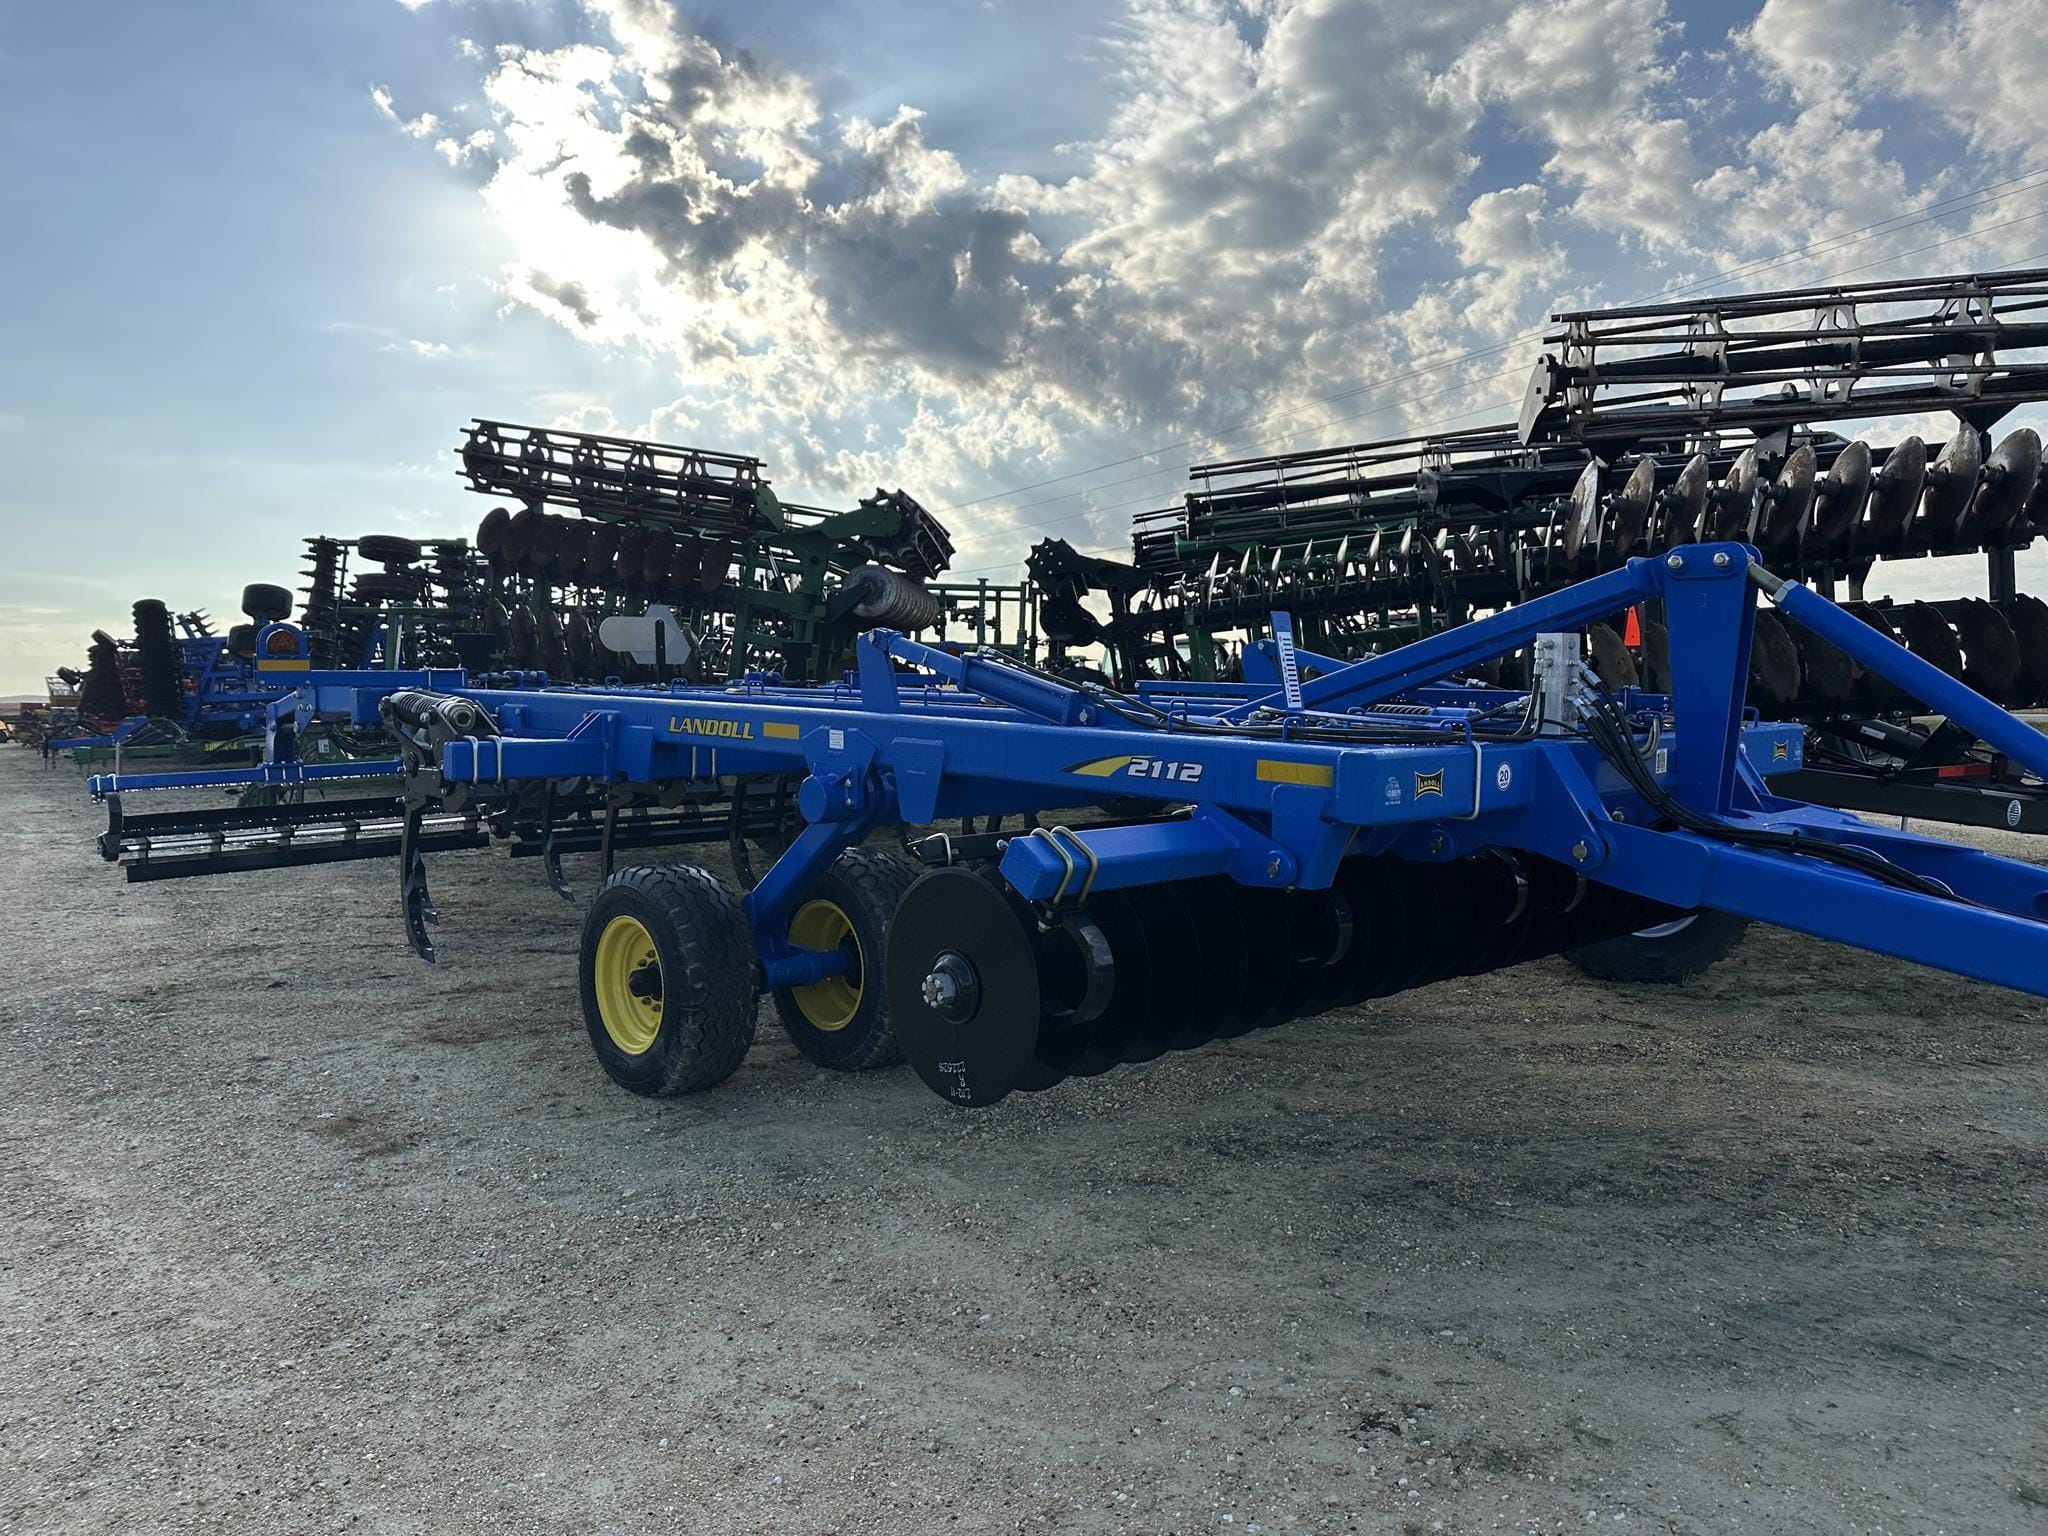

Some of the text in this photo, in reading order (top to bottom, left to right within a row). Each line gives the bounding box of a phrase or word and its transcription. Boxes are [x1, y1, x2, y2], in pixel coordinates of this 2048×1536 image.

[669, 716, 754, 739] LANDOLL
[1127, 758, 1202, 782] 2112
[1499, 770, 1509, 782] 20
